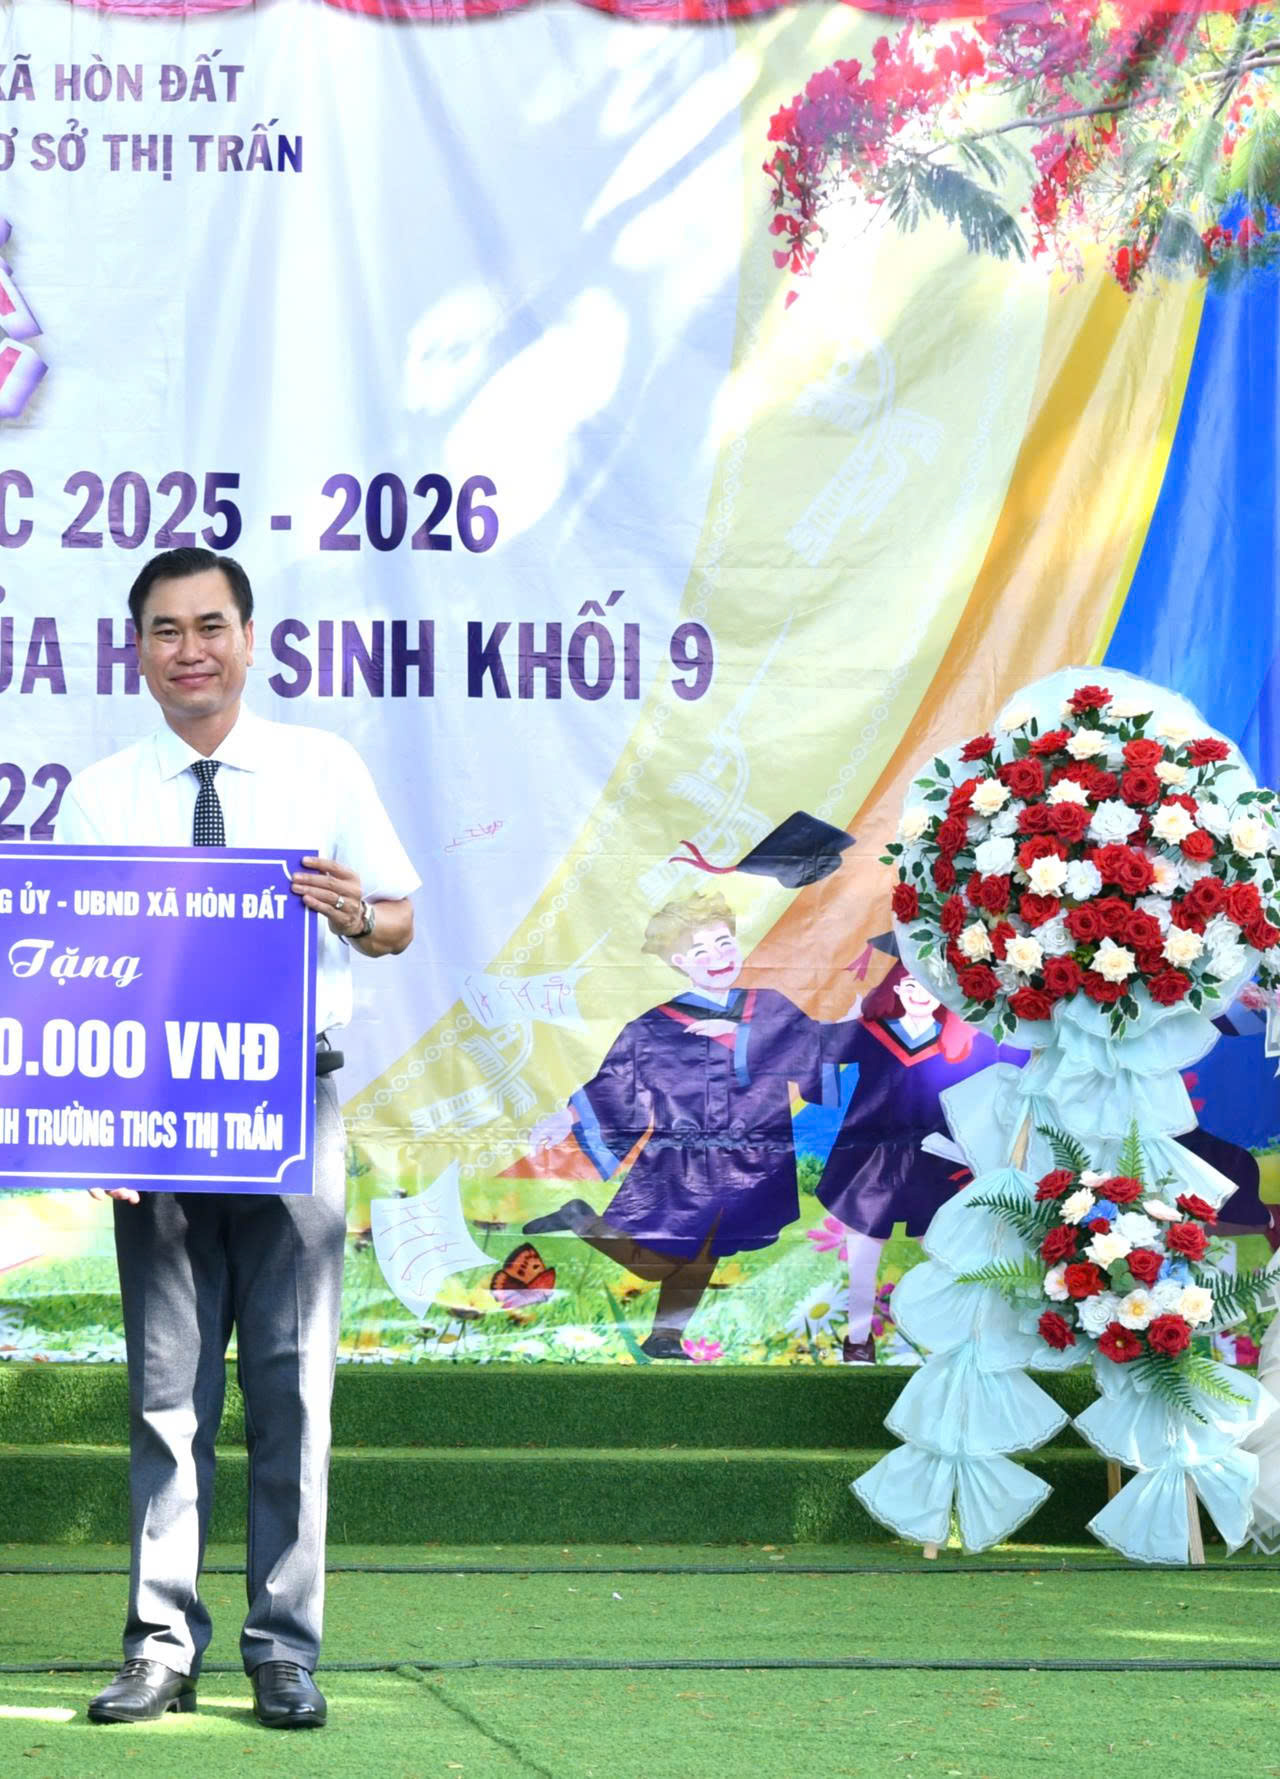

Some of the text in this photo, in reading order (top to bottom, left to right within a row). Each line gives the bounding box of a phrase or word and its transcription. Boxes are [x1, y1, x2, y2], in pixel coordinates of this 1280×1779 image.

[55, 54, 143, 102] HÒN
[158, 49, 244, 102] ĐẤT
[30, 118, 89, 172] SỞ
[103, 134, 173, 182] THỊ
[188, 117, 303, 173] TRẤN
[61, 470, 242, 553] 2025
[270, 513, 292, 532] -
[319, 472, 499, 554] 2026
[268, 618, 435, 698] SINH
[467, 590, 641, 701] KHỐI
[669, 622, 714, 701] 9
[19, 886, 51, 915] ỦY
[74, 890, 140, 917] UBND
[147, 886, 180, 918] XÃ
[186, 886, 236, 919] HÒN
[242, 885, 288, 920] ĐẤT
[8, 938, 143, 987] Tặng
[165, 1020, 280, 1081] VNĐ
[25, 1100, 115, 1149] TRƯỜNG
[121, 1110, 177, 1150] THCS
[184, 1112, 218, 1158] THỊ
[224, 1100, 283, 1152] TRẤN
